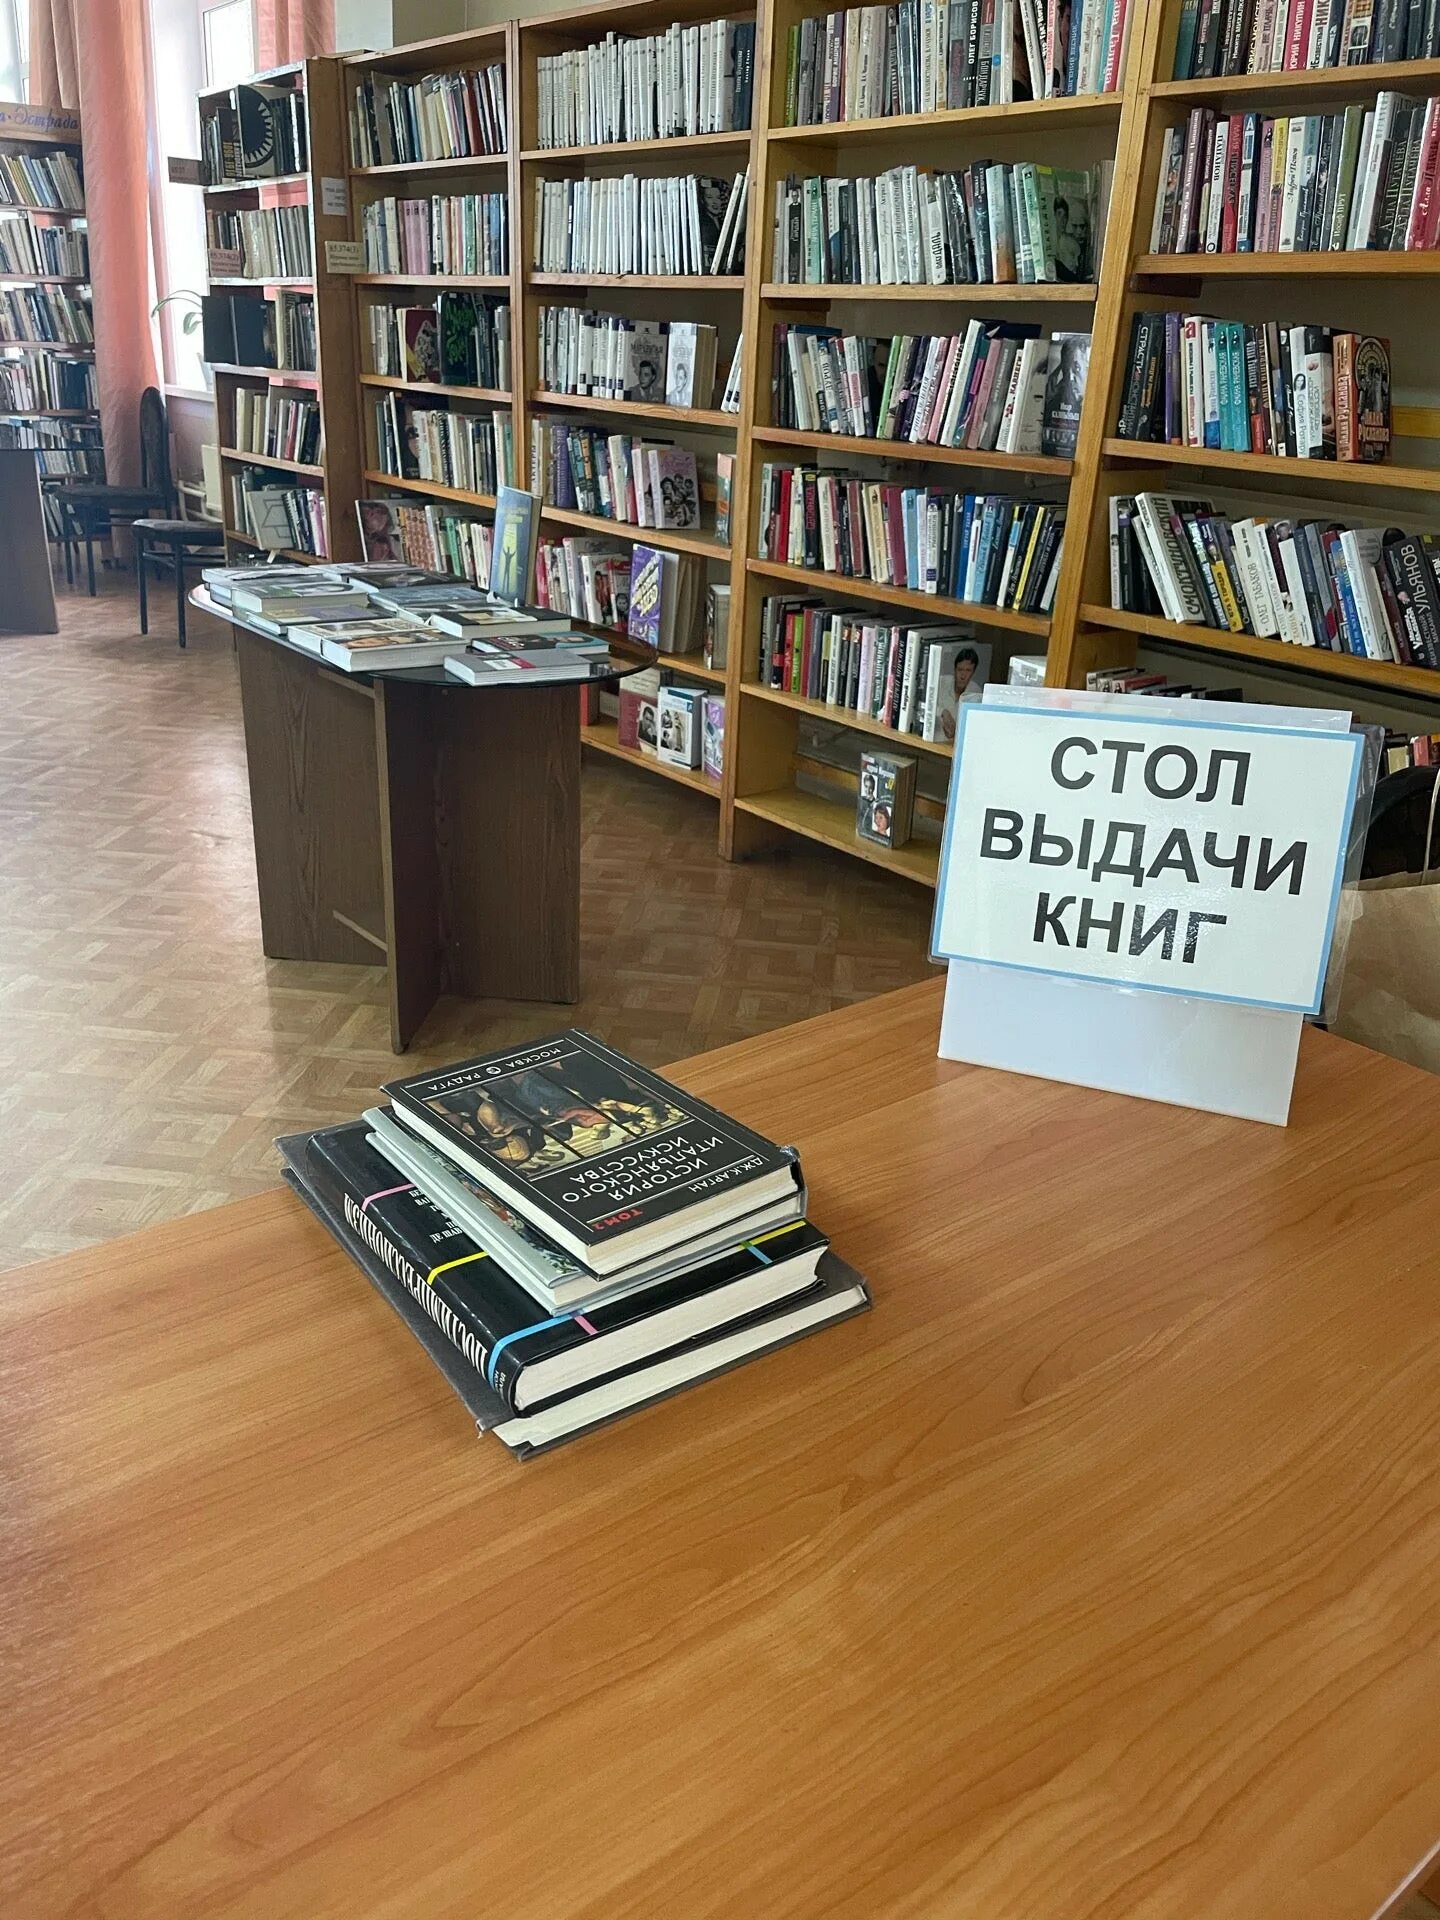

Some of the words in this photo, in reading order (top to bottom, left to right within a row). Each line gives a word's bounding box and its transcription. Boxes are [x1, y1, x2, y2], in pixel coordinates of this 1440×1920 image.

[969, 1, 978, 40] БОРИСОВ
[1293, 2, 1305, 40] НИКУЛИН
[968, 43, 976, 64] ОЛЕГ
[1290, 44, 1299, 69] ЮРИЙ
[1189, 111, 1200, 149] Папанова
[1232, 123, 1241, 151] МАЙЯ
[1185, 152, 1195, 188] Анатолия
[1213, 134, 1224, 181] ПАПАНОВ
[1227, 151, 1239, 204] ПЛИСЕЦКАЯ
[1337, 192, 1346, 213] ПРУТ
[1135, 326, 1148, 371] СТРАСТИ
[1297, 394, 1307, 423] София
[1298, 426, 1307, 455] Ротару
[1151, 496, 1201, 616] СМОКТУНОВСКИЙ
[1246, 562, 1265, 600] ТАБАКОВ
[1400, 543, 1432, 614] УЛЬЯНОВ
[1256, 603, 1271, 624] ОЛЕГ
[1425, 611, 1440, 643] МИХАИЛ
[1418, 614, 1438, 666] НЕИЗВЕСТНЫЙ
[901, 684, 909, 711] Андрей
[1050, 736, 1251, 806] СТОЛ
[979, 807, 1308, 896] ВЫДАЧИ
[1032, 891, 1228, 964] КНИГ
[504, 1047, 562, 1069] МОСКВА
[427, 1072, 481, 1092] РАДУГА
[562, 1136, 723, 1202] ИТАЛЬЯНСКОГО
[569, 1136, 690, 1184] ИСКУССТВА
[608, 1157, 708, 1201] ИСТОРИЯ
[605, 1208, 643, 1227] ТОМ
[344, 1192, 488, 1381] ПОСТИМПРЕССИОНИЗМ
